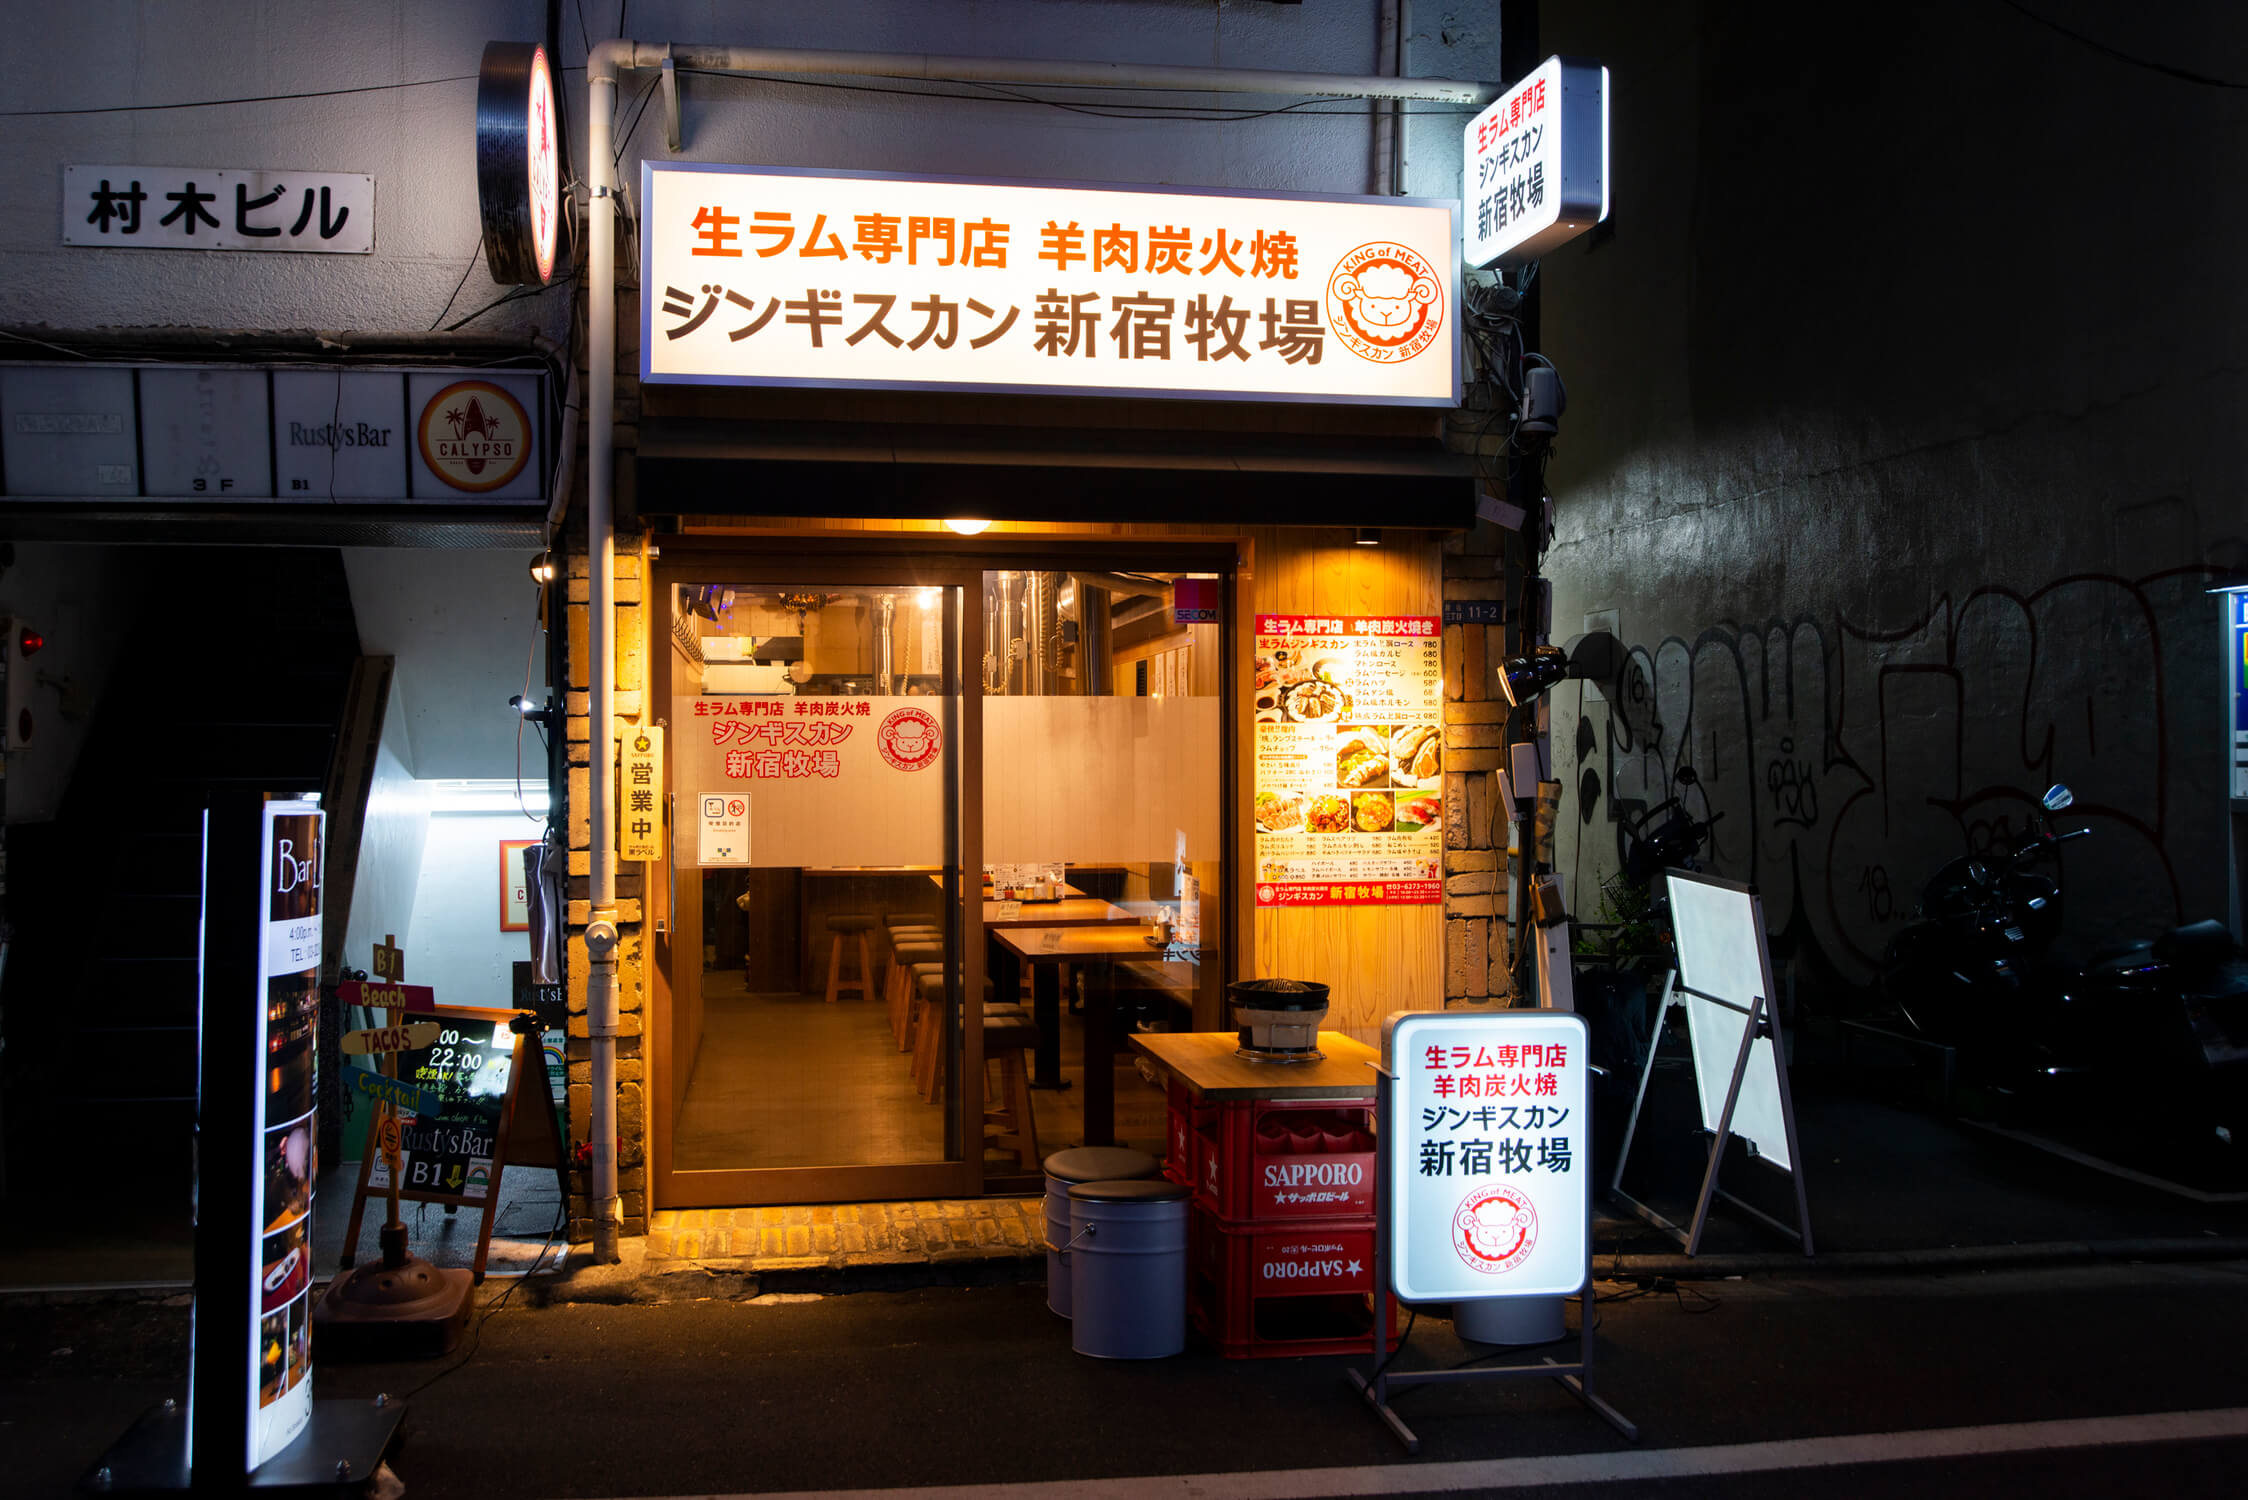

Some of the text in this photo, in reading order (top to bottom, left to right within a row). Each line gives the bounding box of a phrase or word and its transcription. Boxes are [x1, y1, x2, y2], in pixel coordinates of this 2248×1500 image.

[1478, 78, 1546, 155] 生ラム専門店
[1479, 124, 1543, 189] ジンギスカン
[87, 179, 349, 241] 村木ビル
[1478, 161, 1545, 242] 新宿牧場
[691, 206, 1299, 281] 生ラム専門店 羊肉炭火焼
[1343, 247, 1429, 276] KING of MEAT
[662, 285, 1325, 366] ジンギスカン 新宿牧場
[1333, 315, 1438, 360] ジンギスカン 新宿牧場
[289, 422, 390, 451] Rusty's Bar
[440, 443, 512, 456] CALYPSO
[292, 480, 309, 490] B1
[1177, 609, 1216, 620] SECOM
[1264, 620, 1343, 634] 生ラム専門店
[694, 701, 871, 717] 生ラム専門店 羊肉炭火焼
[712, 722, 853, 746] ジンギスカン
[726, 751, 841, 779] 新宿牧場
[631, 762, 653, 841] 営業中
[277, 839, 312, 893] Bar
[1278, 893, 1323, 901] ジンギスカン
[1330, 886, 1383, 900] 新宿牧場
[377, 949, 396, 973] B1
[361, 983, 406, 1008] Beach
[361, 1028, 411, 1053] TACOS
[429, 1048, 482, 1070] 22:00
[1424, 1044, 1567, 1070] 生ラム専門店
[358, 1073, 420, 1110] Cocktail
[1434, 1072, 1558, 1098] 羊肉炭火焼
[1422, 1105, 1569, 1132] ジンギスカン
[460, 1128, 493, 1156] Bar
[1420, 1137, 1572, 1176] 新宿牧場
[412, 1161, 443, 1184] B1
[1264, 1163, 1362, 1187] SAPPORO
[1288, 1191, 1349, 1203] サッポロビール
[1465, 1188, 1527, 1208] KING of MEAT
[1263, 1260, 1343, 1278] SAPPORO
